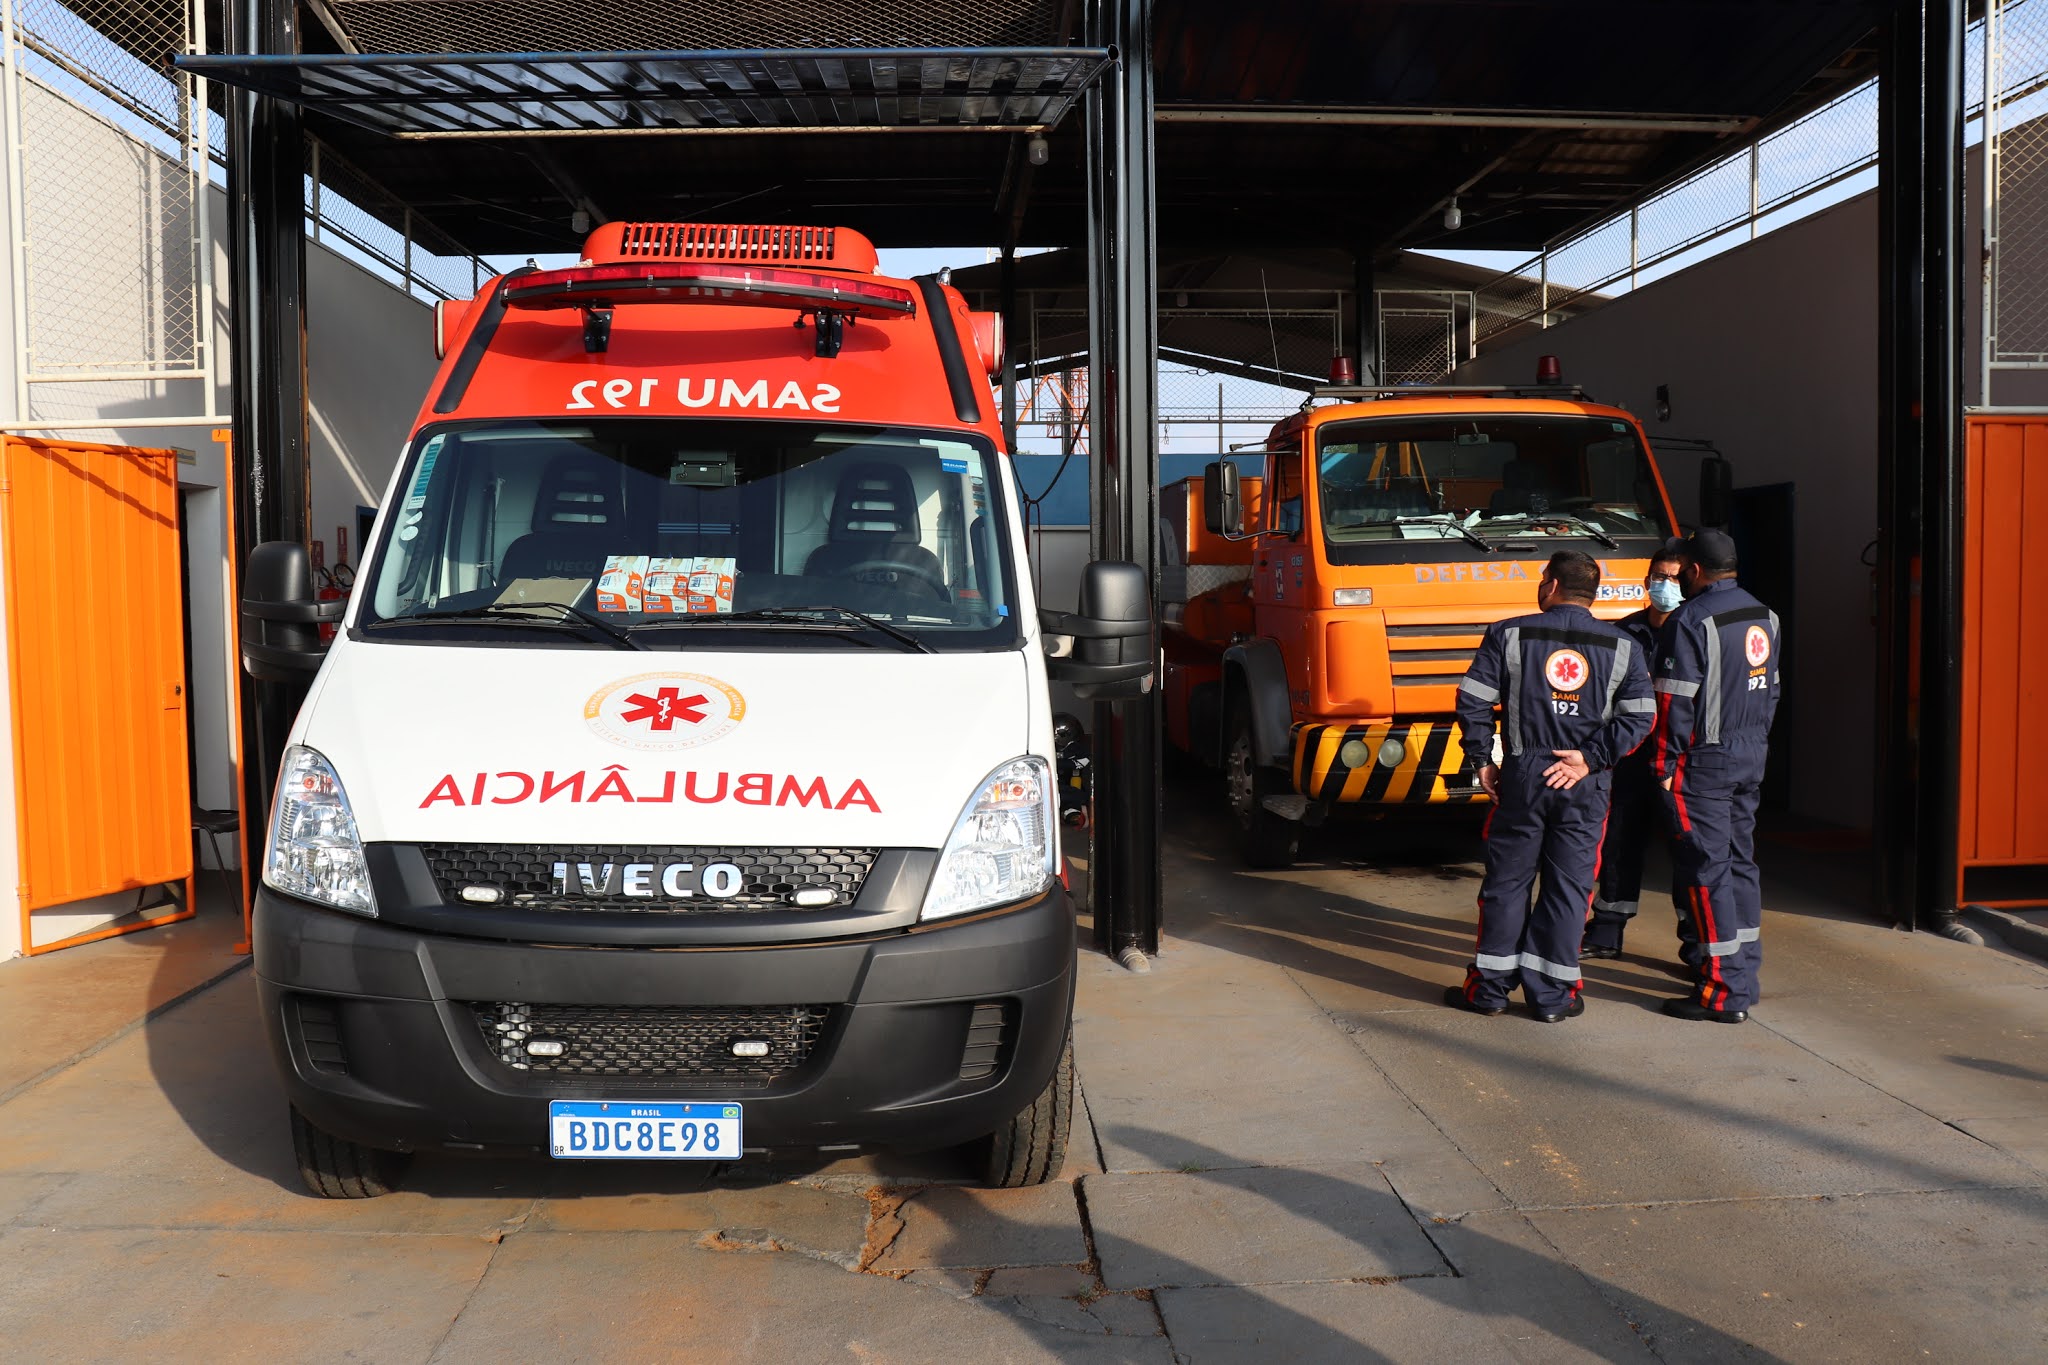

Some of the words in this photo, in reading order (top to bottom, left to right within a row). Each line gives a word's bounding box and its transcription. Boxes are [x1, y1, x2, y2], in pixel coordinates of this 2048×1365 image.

[1414, 562, 1528, 584] DEFESA
[1749, 667, 1767, 678] SAMU
[1748, 675, 1767, 692] 192
[1551, 691, 1580, 702] SAMU
[1551, 700, 1579, 717] 192
[552, 861, 743, 898] IVECO
[631, 1109, 662, 1117] BRASIL
[569, 1121, 720, 1152] BDC8E98
[554, 1145, 565, 1155] BR
